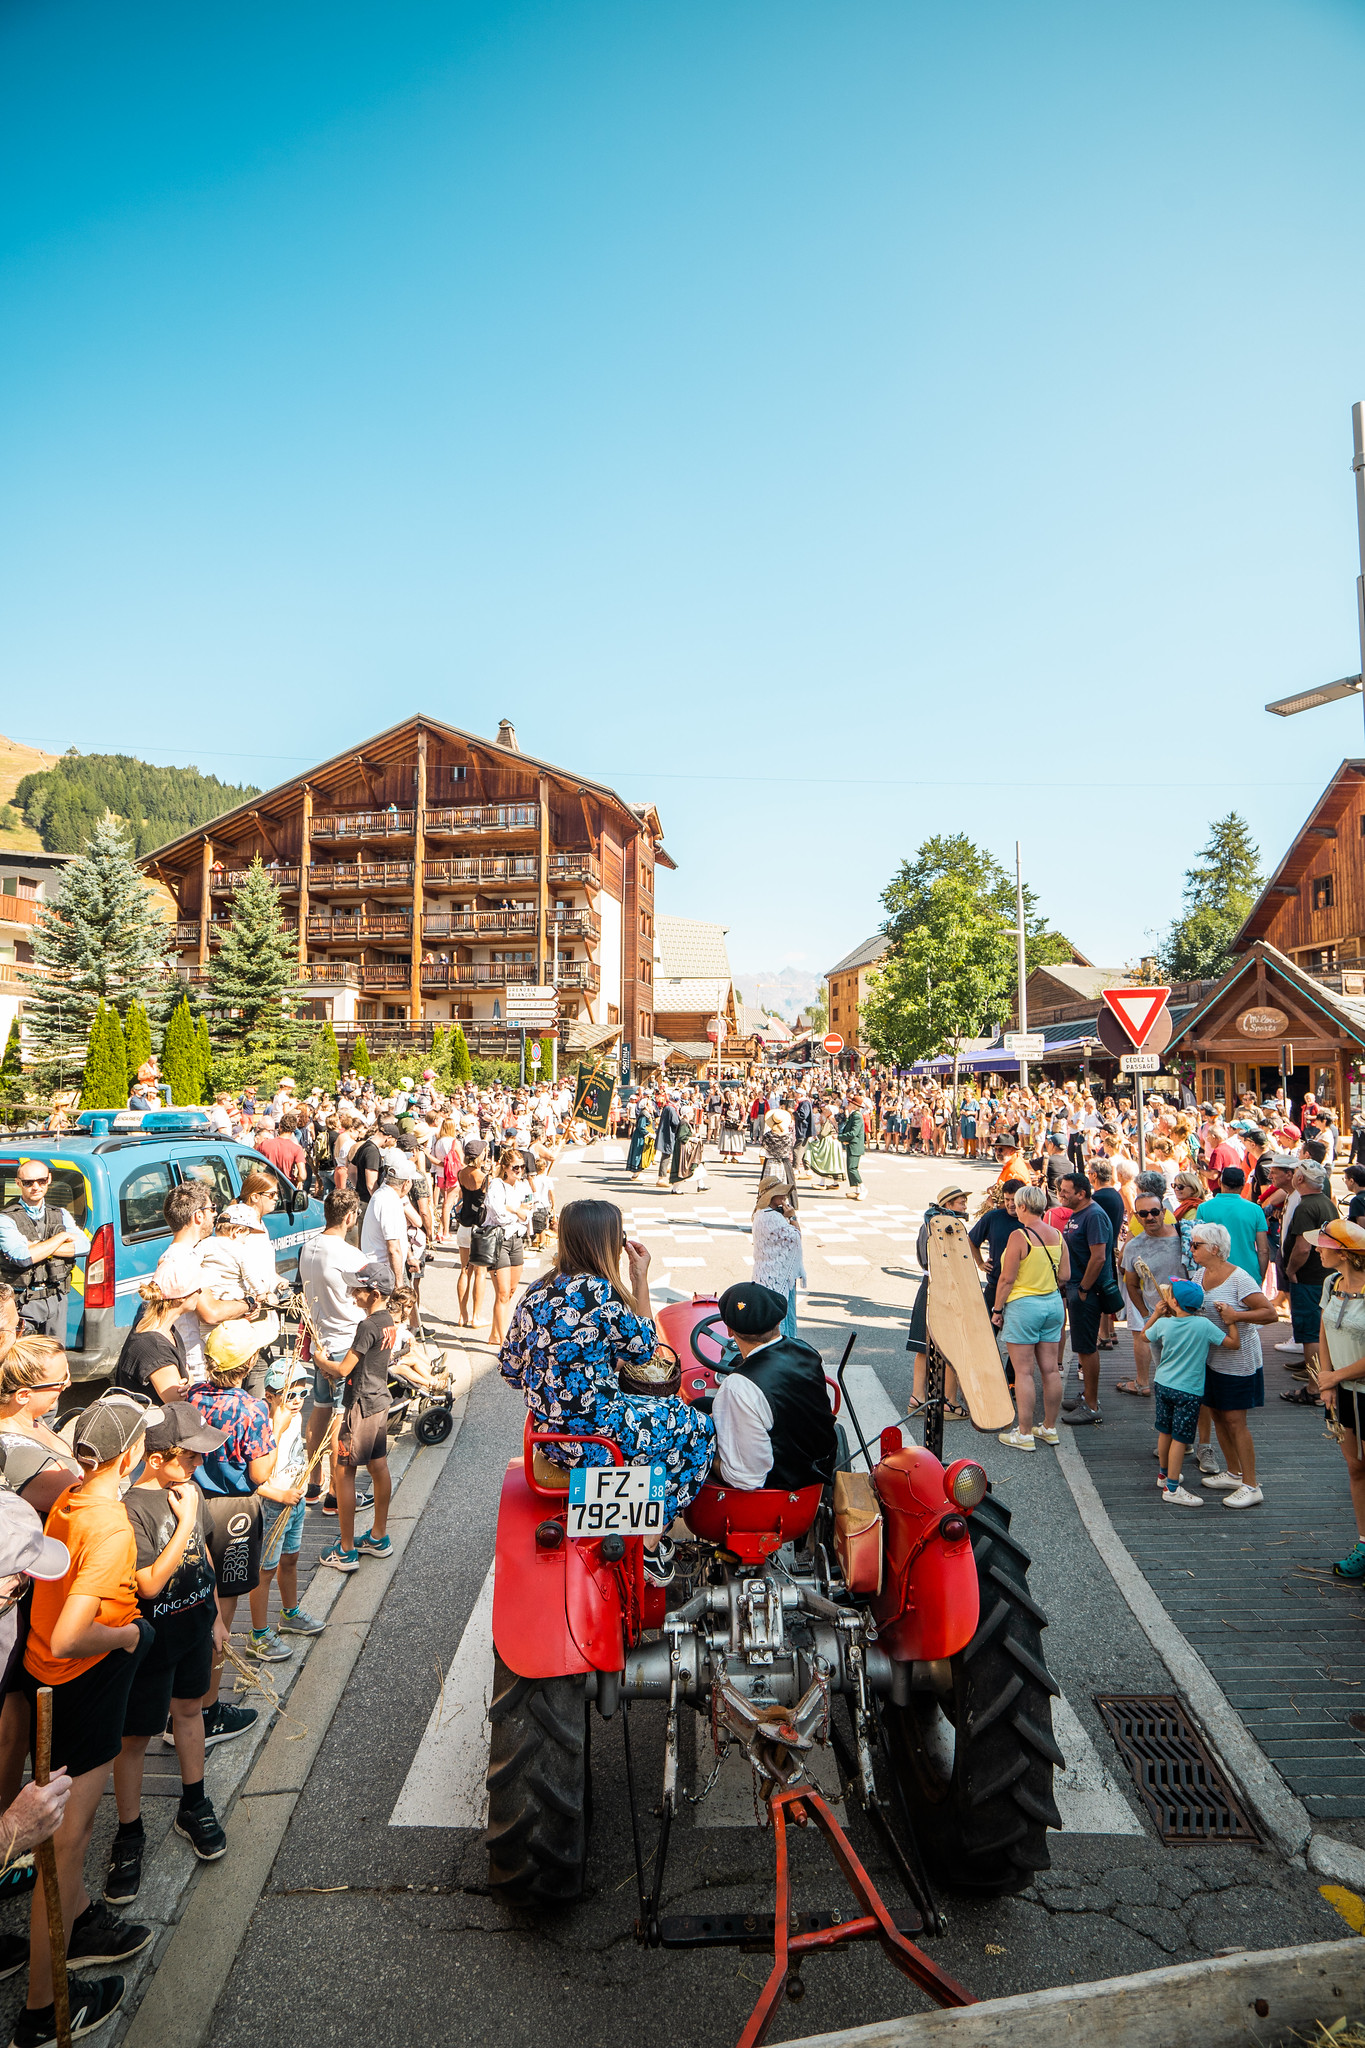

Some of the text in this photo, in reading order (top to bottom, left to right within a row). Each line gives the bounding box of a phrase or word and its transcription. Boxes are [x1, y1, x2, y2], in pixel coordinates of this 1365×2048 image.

[1250, 1023, 1277, 1032] Sports
[949, 1063, 975, 1073] SORTS
[574, 1487, 581, 1495] F
[651, 1485, 664, 1498] 38
[572, 1501, 660, 1530] 792-VQ
[153, 1599, 182, 1618] KING
[189, 1584, 211, 1605] SNOW
